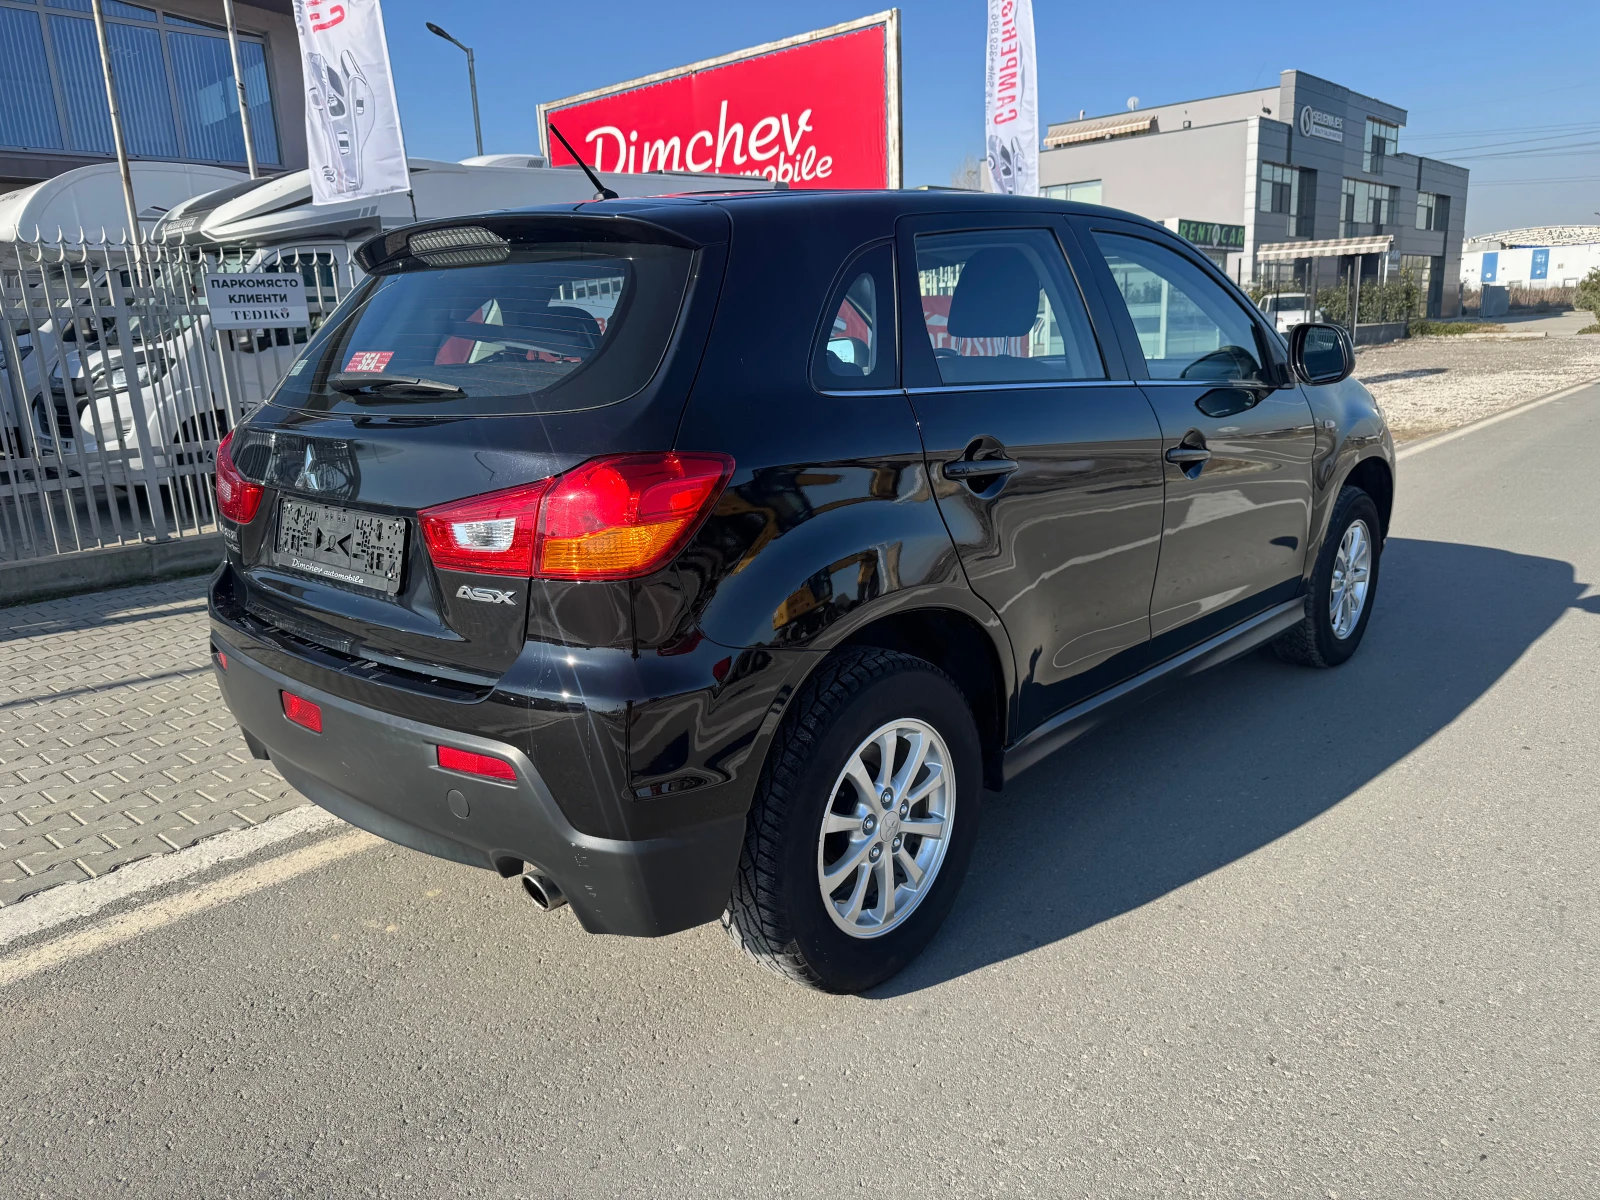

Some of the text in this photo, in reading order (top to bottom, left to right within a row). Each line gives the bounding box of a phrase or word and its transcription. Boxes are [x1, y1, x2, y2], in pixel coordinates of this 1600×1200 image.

[585, 100, 813, 174] Dimchev
[1180, 222, 1213, 243] RENT
[1221, 226, 1245, 245] CAR
[211, 279, 299, 289] ПАРКОМЯСТО
[228, 293, 288, 304] КЛИЕНТИ
[292, 558, 364, 584] Dimchev automobile
[455, 585, 518, 606] ASX
